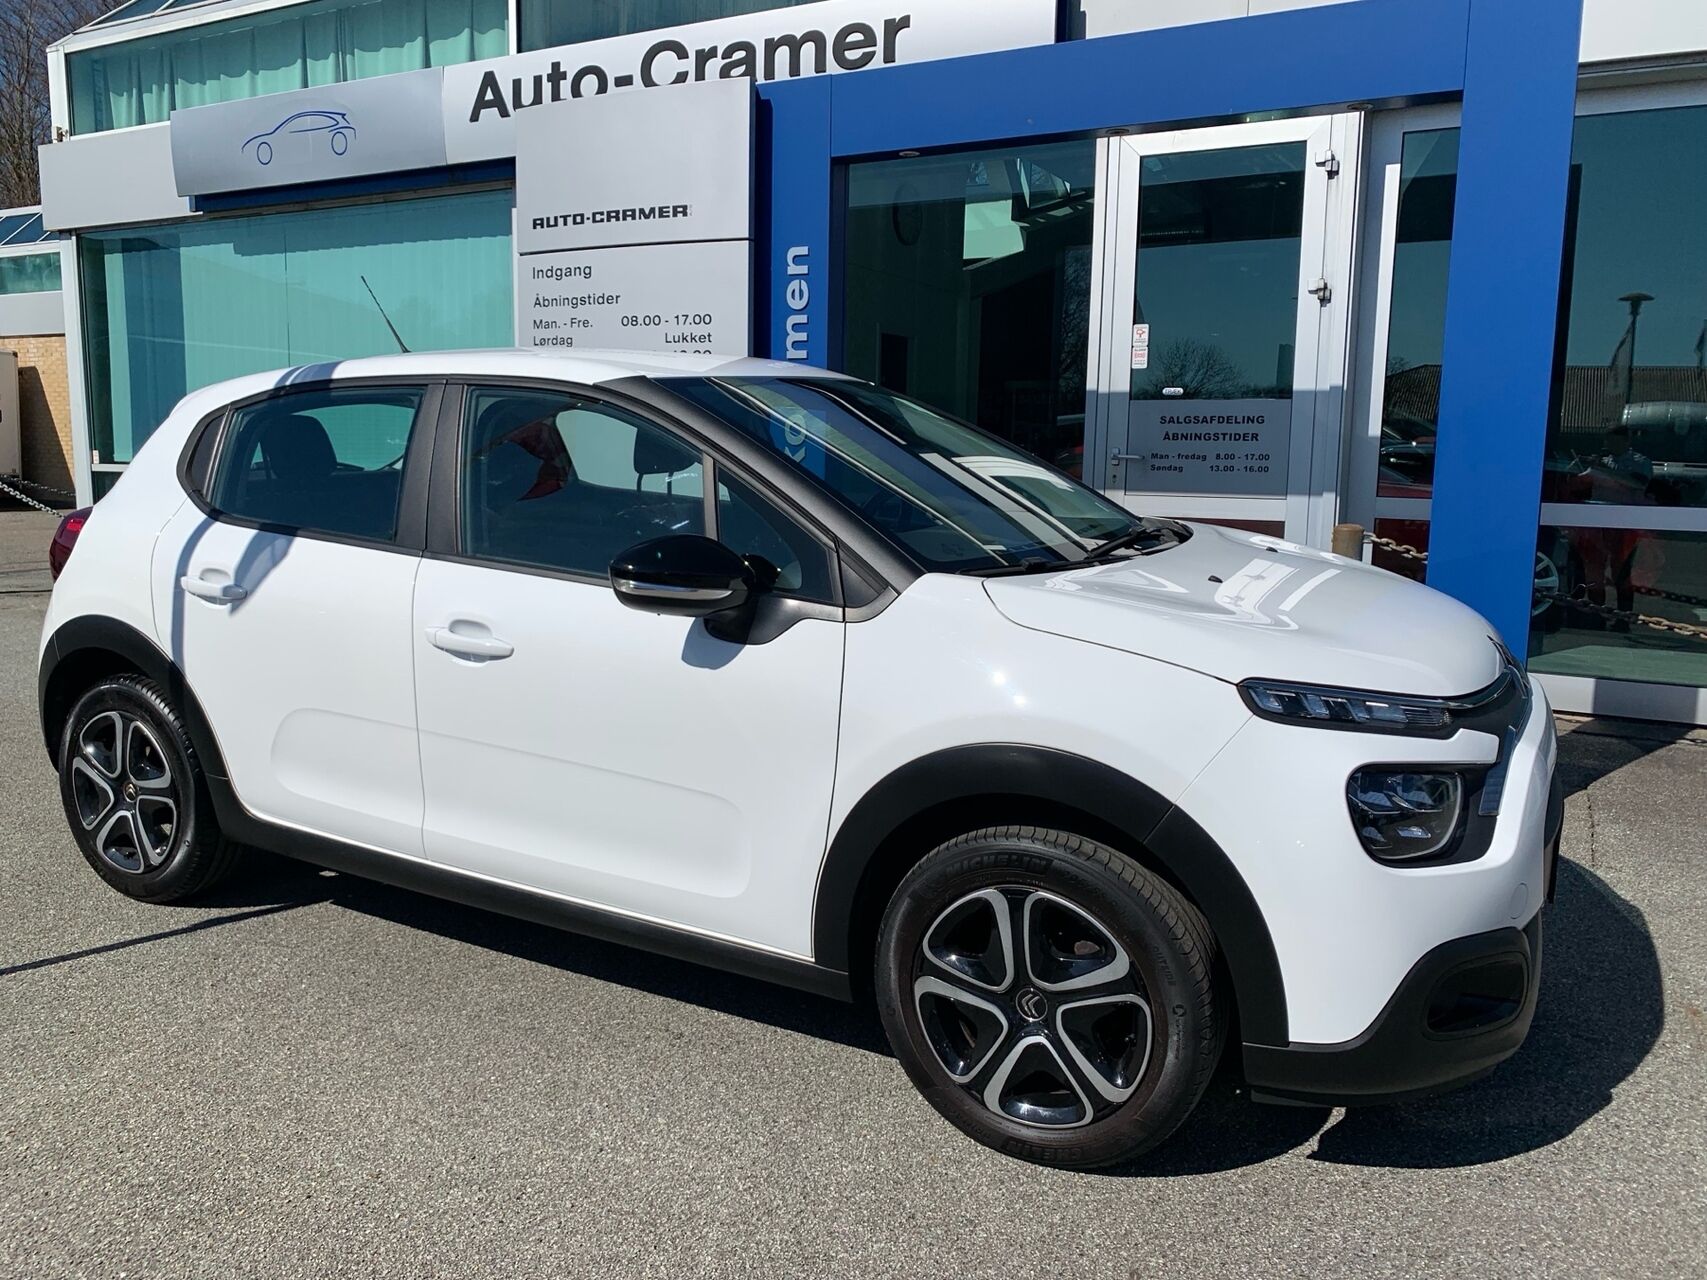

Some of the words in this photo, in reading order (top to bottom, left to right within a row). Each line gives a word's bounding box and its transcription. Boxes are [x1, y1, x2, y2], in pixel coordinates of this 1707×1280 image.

[469, 14, 911, 123] Auto-Cramer
[532, 265, 592, 281] Indgang
[533, 293, 621, 309] Åbningstider
[533, 319, 561, 330] Man.
[570, 318, 593, 329] Fre.
[621, 315, 661, 327] 08.00
[674, 314, 712, 326] 17.00
[533, 335, 573, 348] Lørdag
[664, 332, 712, 344] Lukket
[1160, 415, 1265, 425] SALGSAFDELING
[1162, 431, 1260, 442] ÅBNINGSTIDER
[1177, 453, 1207, 462] fredag
[1215, 453, 1236, 461] 8.00
[1244, 453, 1270, 461] 17.00
[1150, 464, 1184, 473] Søndag
[1209, 465, 1235, 473] 13.00
[1243, 465, 1270, 473] 16.00
